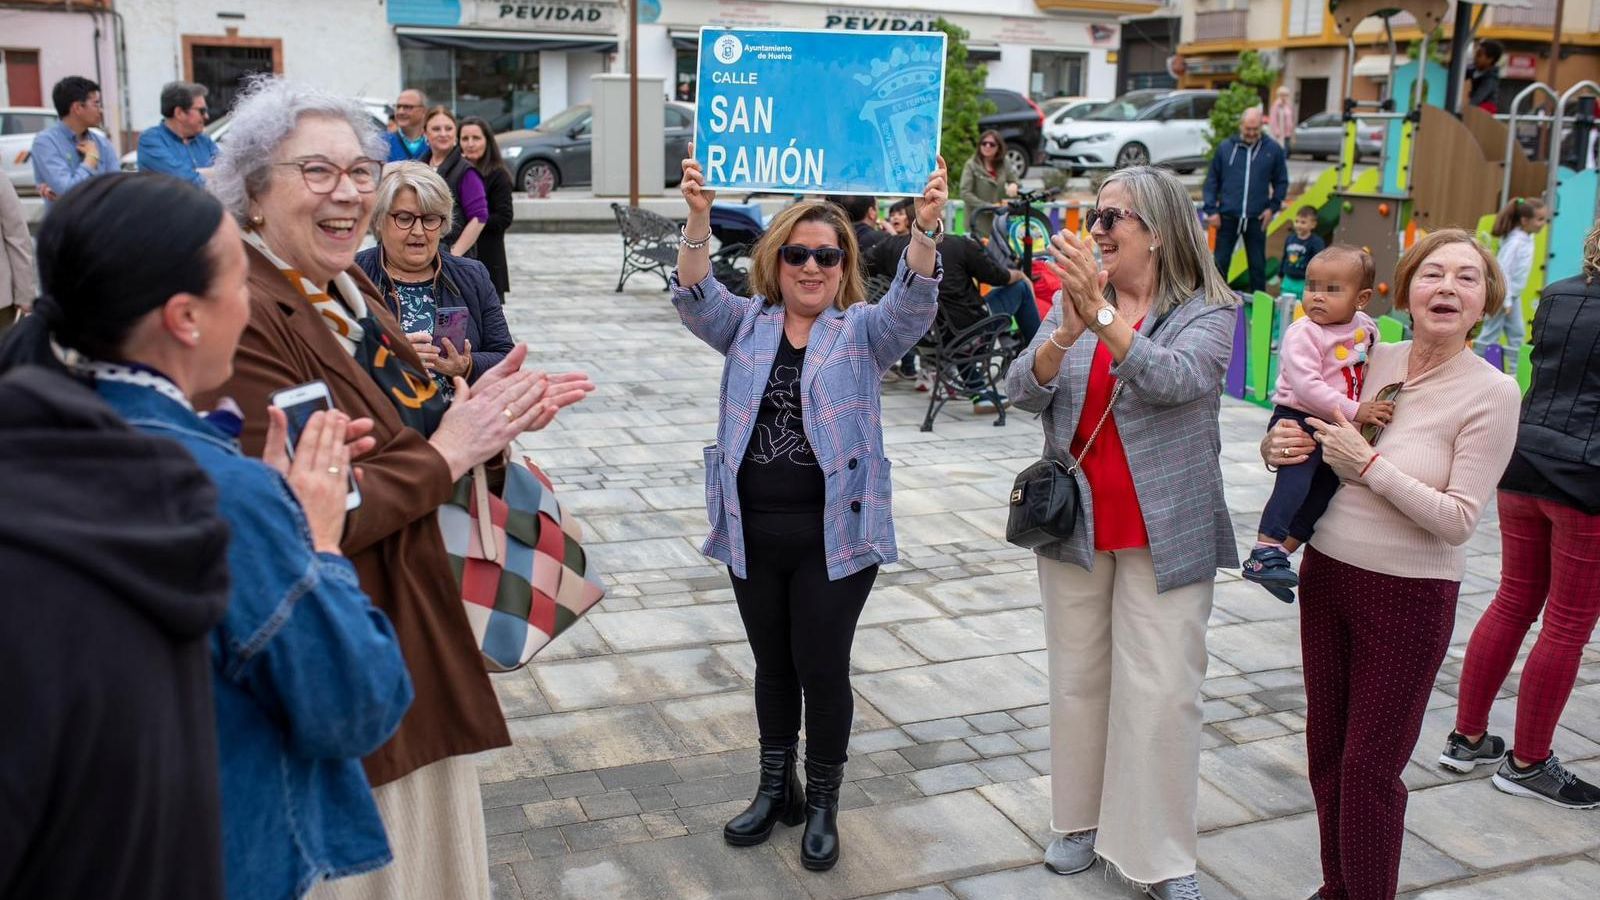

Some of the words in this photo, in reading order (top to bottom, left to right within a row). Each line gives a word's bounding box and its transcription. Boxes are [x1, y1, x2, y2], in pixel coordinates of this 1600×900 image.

[499, 4, 602, 22] PEVIDAD
[744, 44, 792, 53] Ayuntamiento
[757, 52, 767, 60] de
[768, 52, 792, 60] Huelva
[712, 71, 758, 85] CALLE
[709, 95, 774, 134] SAN
[706, 138, 824, 185] RAMÓN
